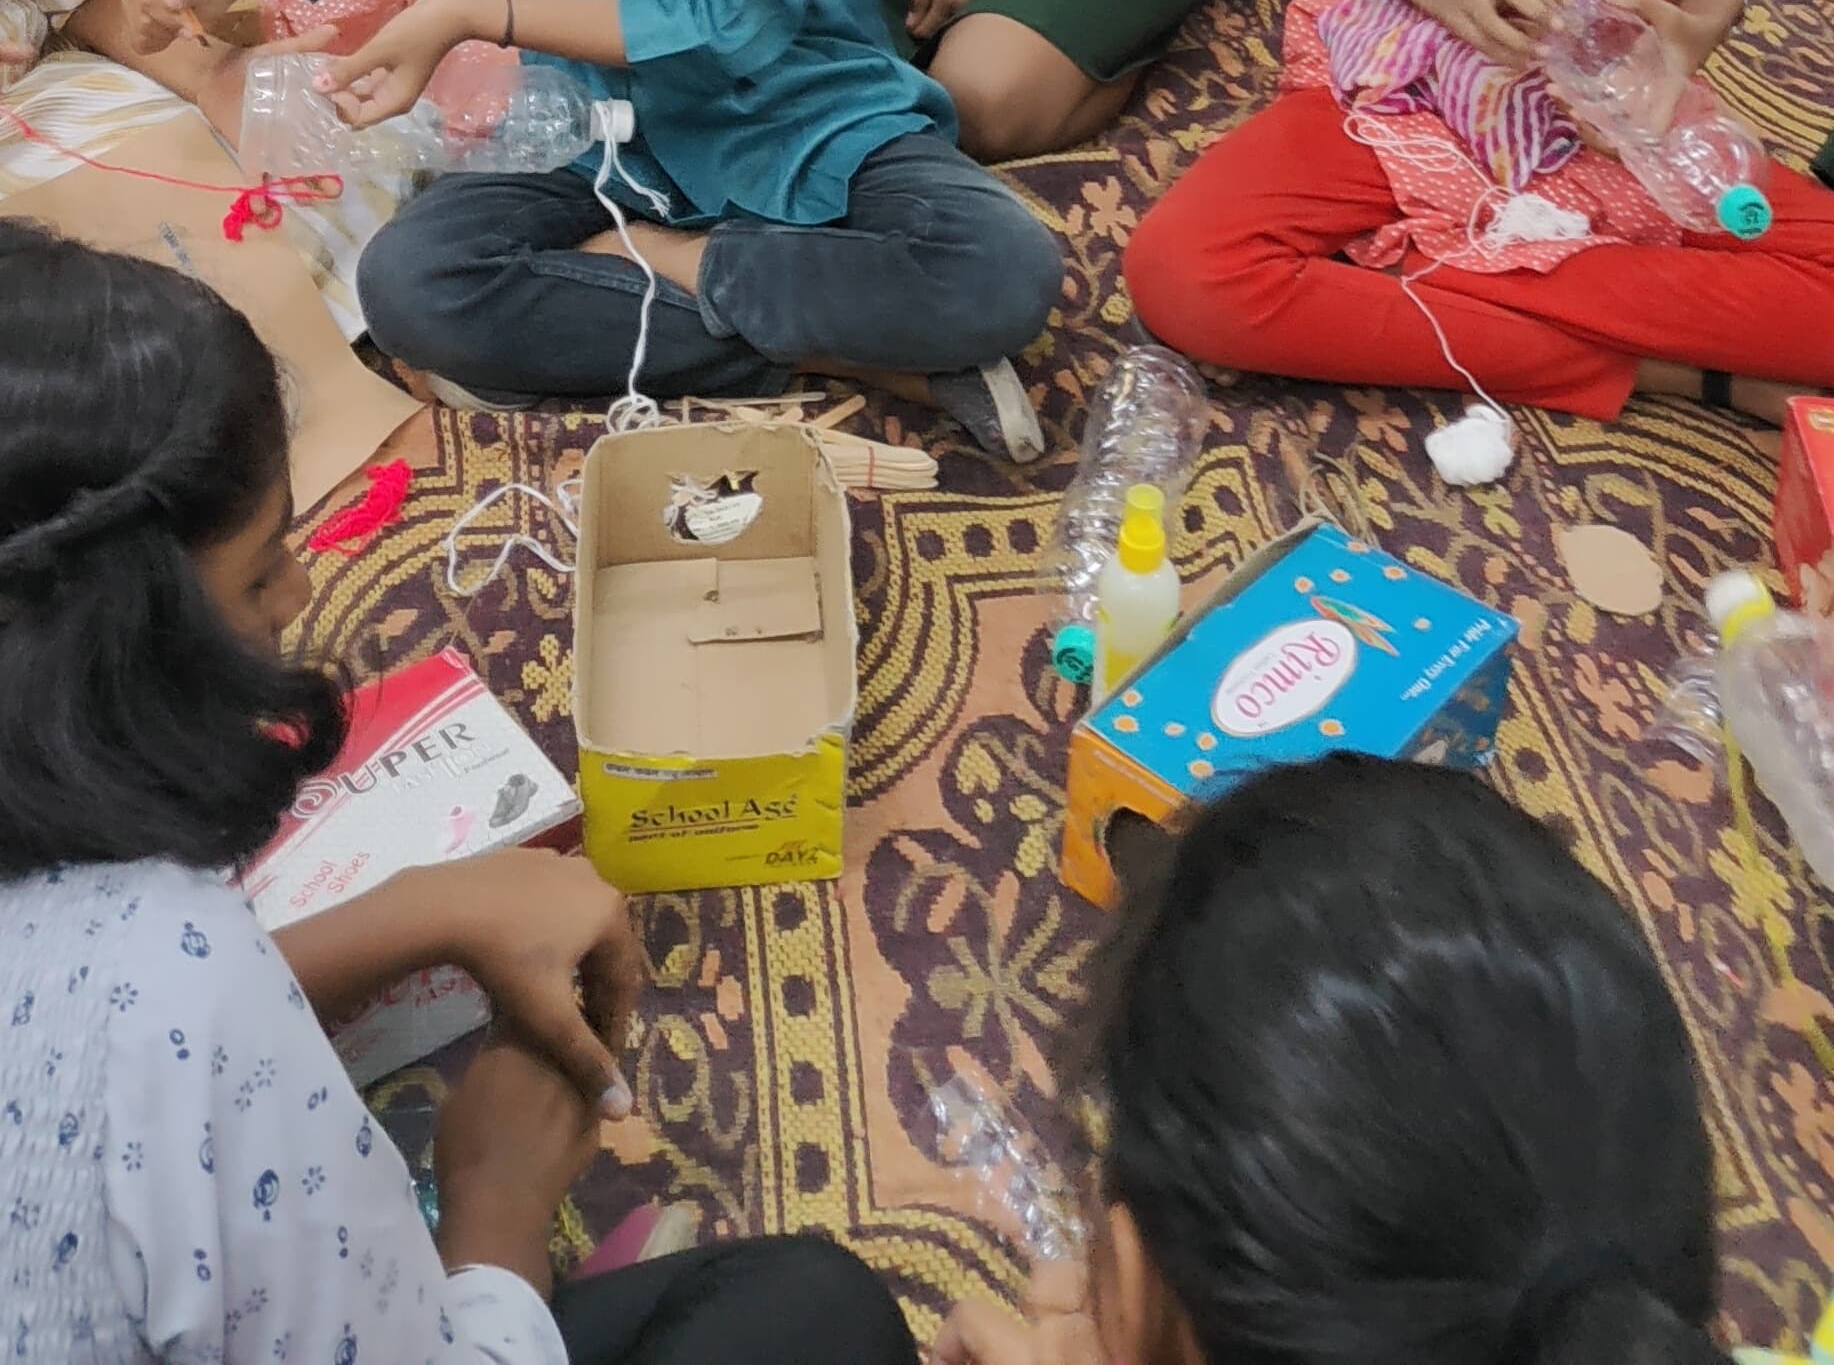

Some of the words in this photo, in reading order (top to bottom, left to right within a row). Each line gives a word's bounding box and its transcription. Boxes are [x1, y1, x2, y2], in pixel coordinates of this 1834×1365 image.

[1235, 631, 1341, 719] Rimco
[291, 722, 476, 819] SUPER
[630, 800, 730, 829] School
[289, 860, 338, 908] School
[327, 850, 371, 894] Shoes
